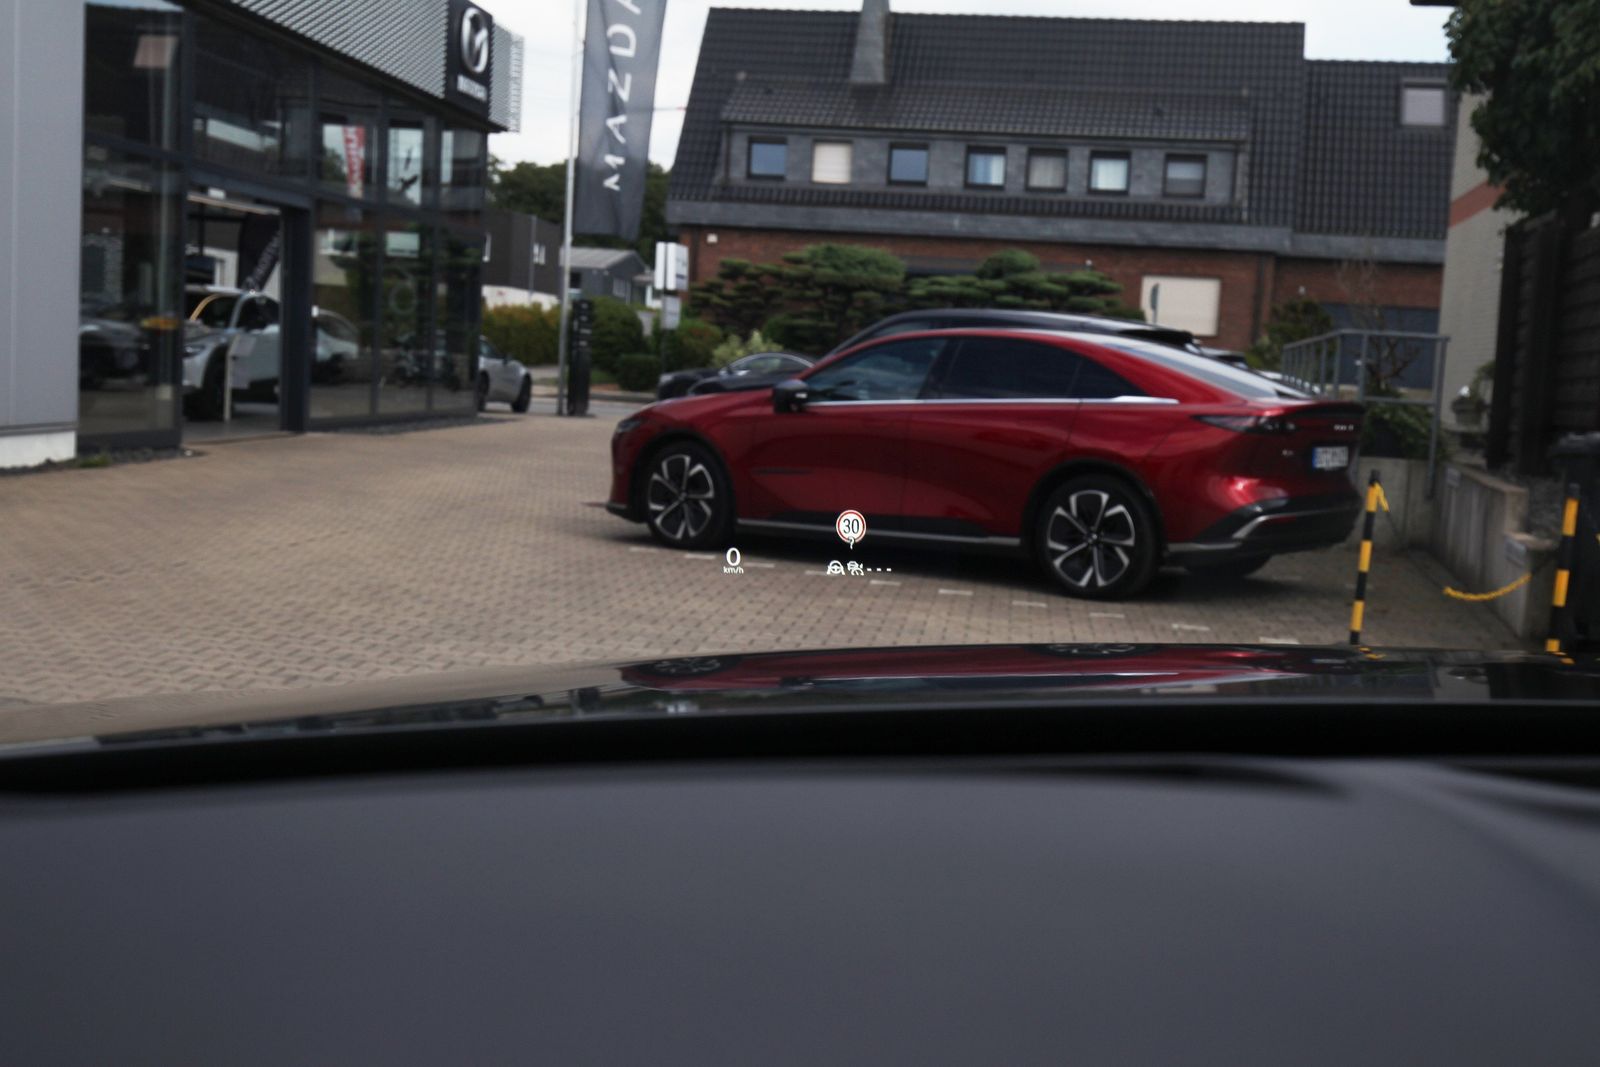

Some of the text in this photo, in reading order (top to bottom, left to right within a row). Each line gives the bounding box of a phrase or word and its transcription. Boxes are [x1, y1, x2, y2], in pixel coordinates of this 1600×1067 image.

[843, 518, 860, 534] 30
[726, 547, 741, 566] 0
[723, 566, 744, 574] km/h
